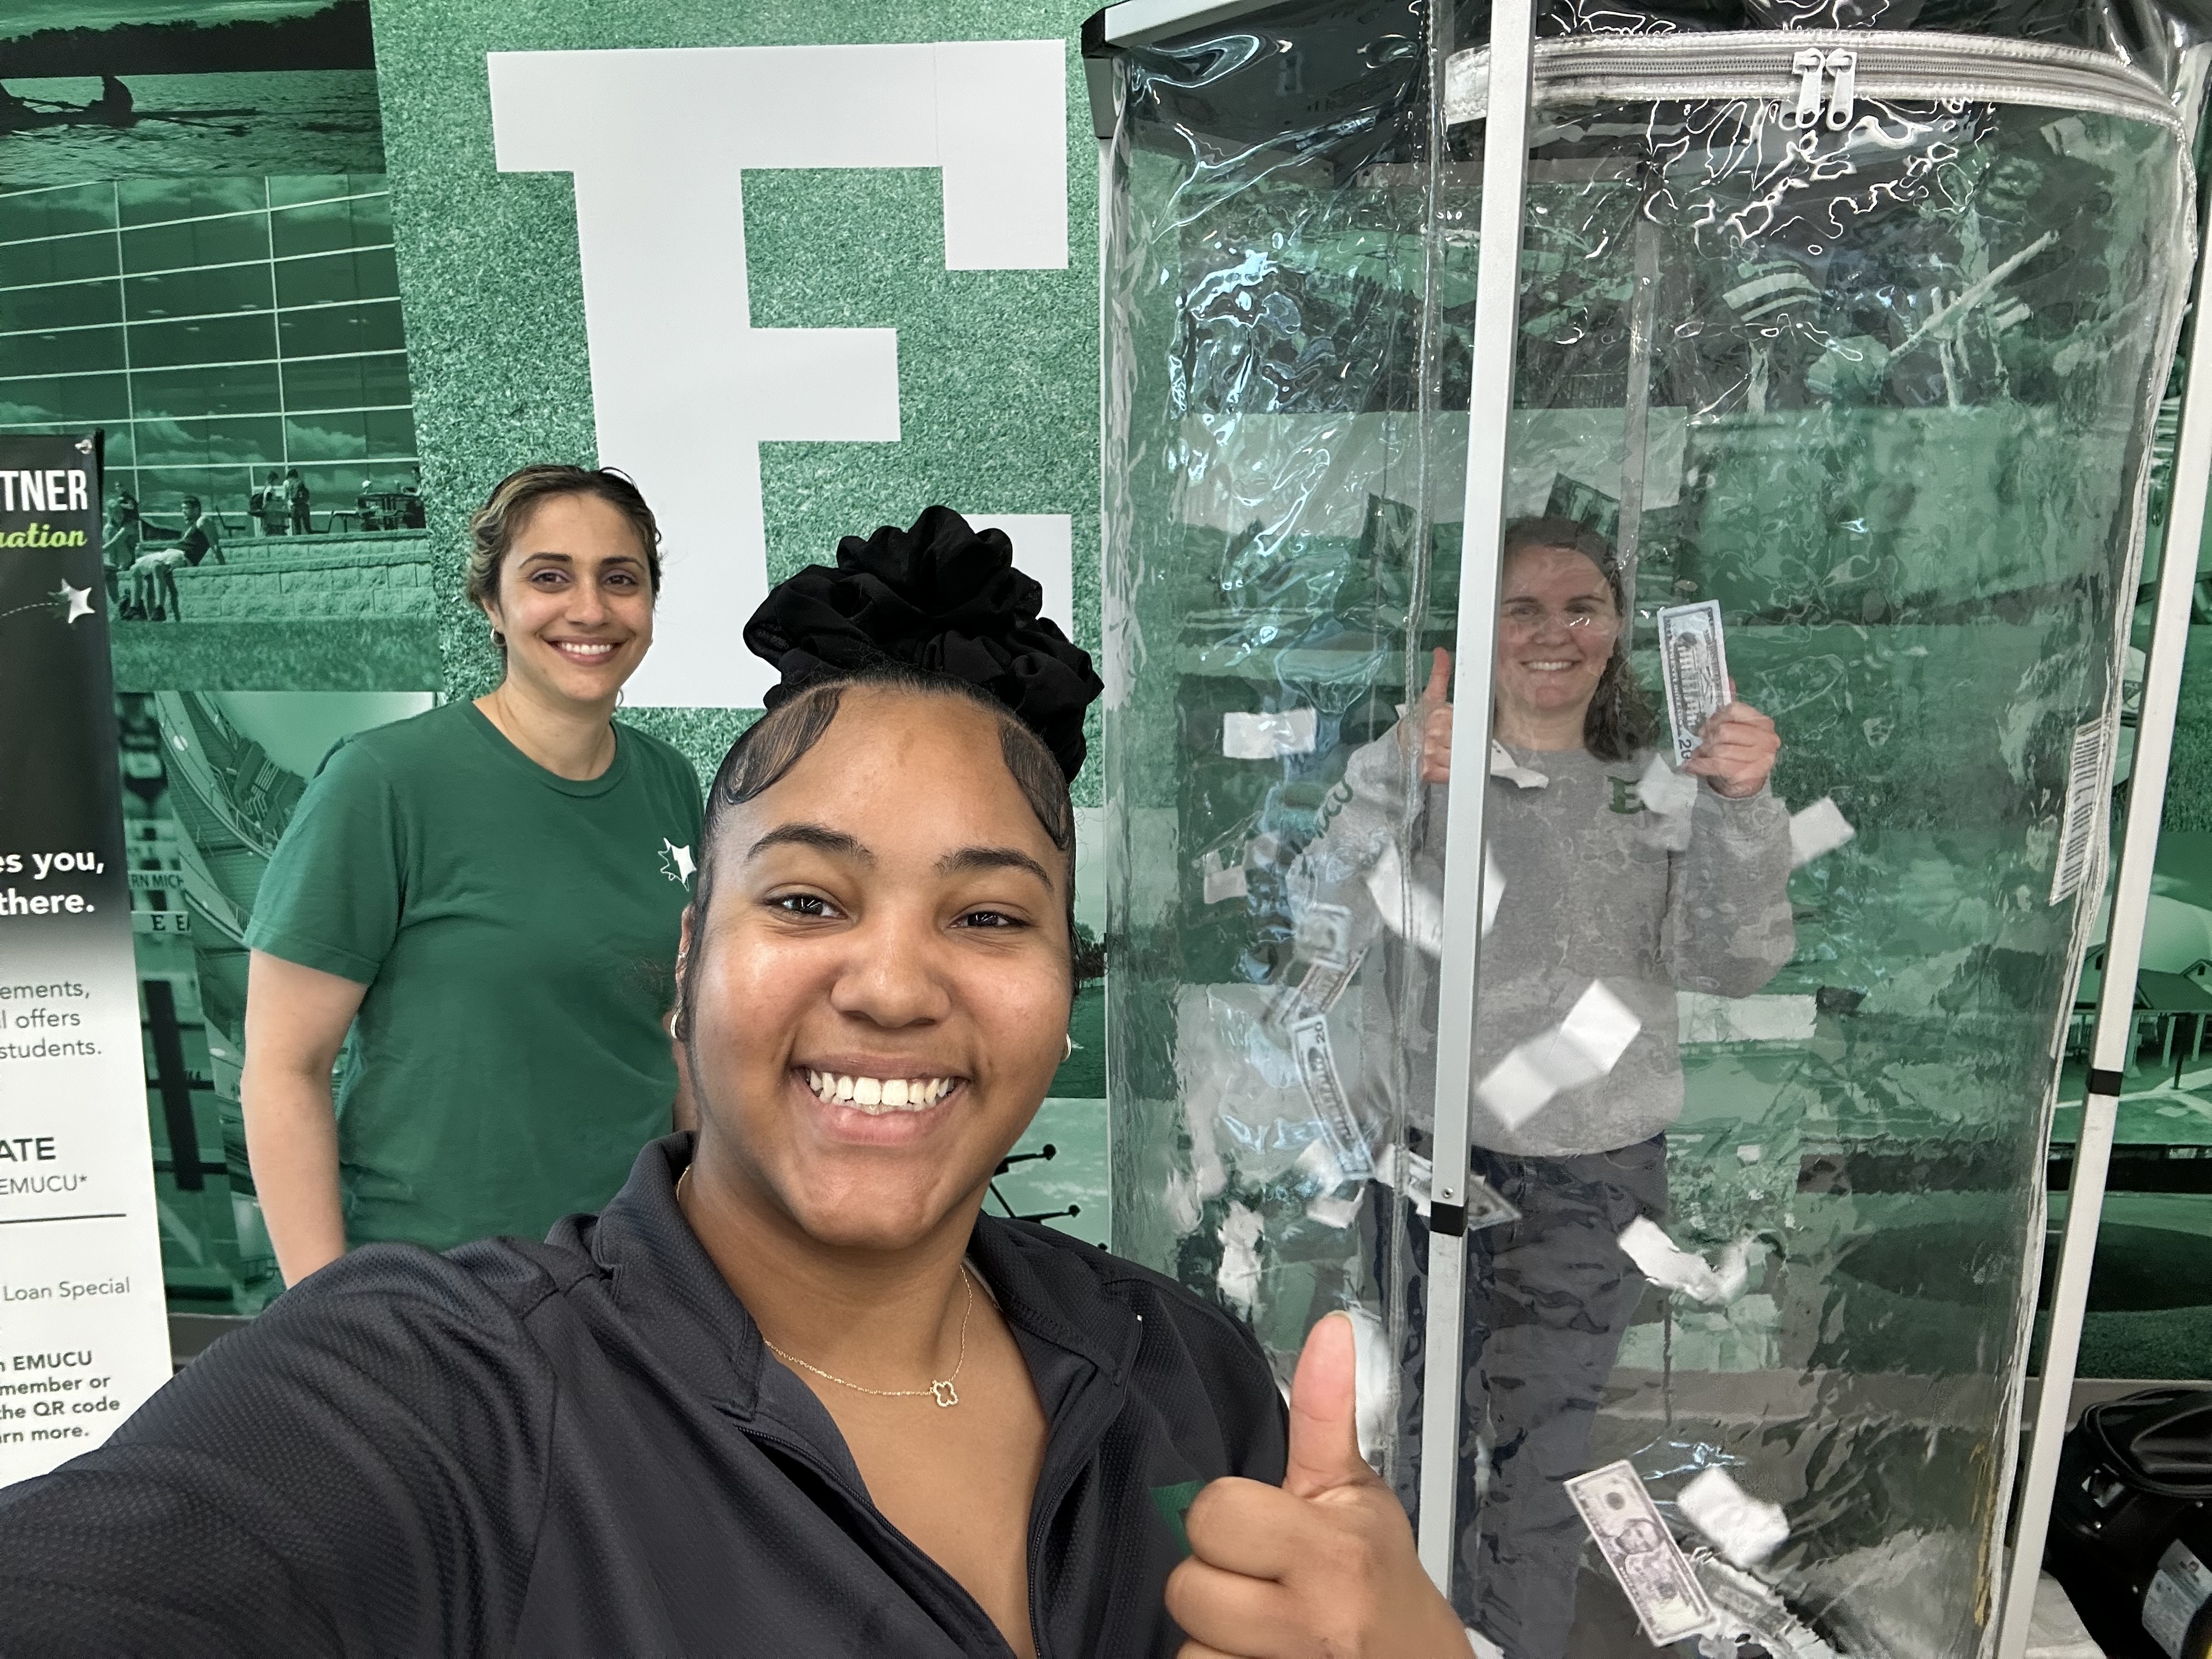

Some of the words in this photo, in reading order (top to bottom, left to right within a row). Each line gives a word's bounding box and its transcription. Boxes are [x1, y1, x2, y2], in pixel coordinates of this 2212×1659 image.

[487, 40, 1071, 708] E
[0, 470, 88, 511] TNER
[0, 853, 23, 874] s
[32, 851, 104, 880] you,
[0, 888, 94, 916] there.
[0, 981, 89, 1000] ements,
[16, 1007, 81, 1029] offers
[0, 1037, 102, 1059] students.
[0, 1137, 56, 1163] ATE
[3, 1285, 53, 1301] Loan
[59, 1277, 131, 1299] Special
[13, 1350, 92, 1371] EMUCU
[0, 1376, 82, 1396] member
[89, 1376, 111, 1389] or
[0, 1404, 26, 1420] he
[33, 1400, 65, 1417] QR
[72, 1396, 121, 1414] code
[0, 1432, 24, 1444] rn
[31, 1425, 89, 1441] more.
